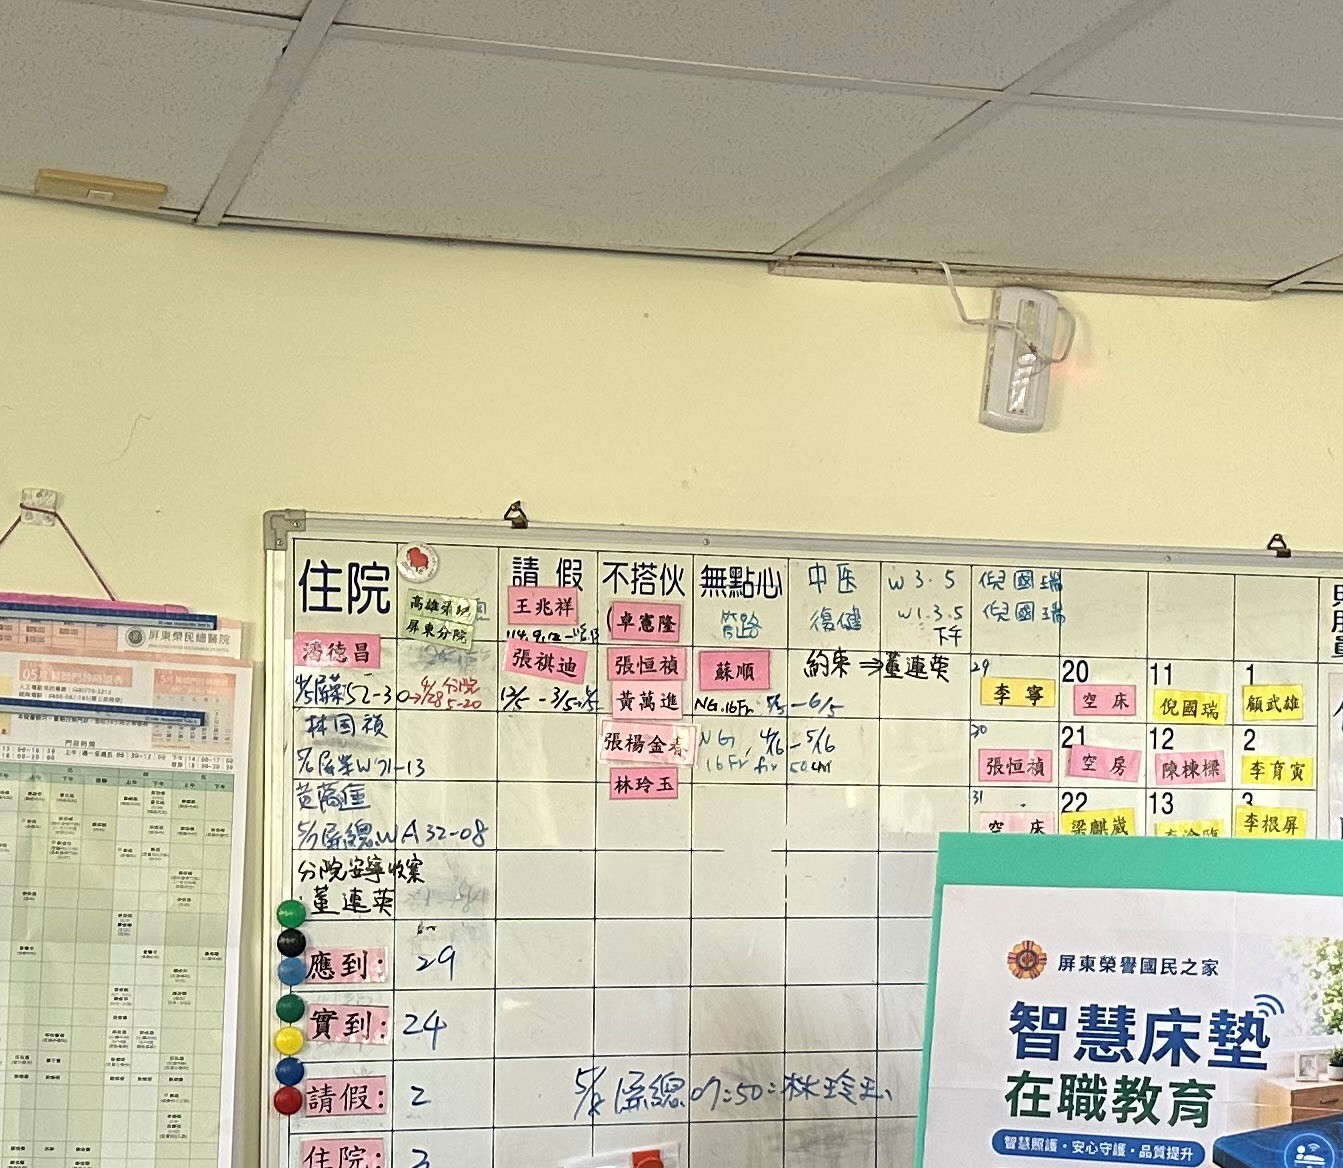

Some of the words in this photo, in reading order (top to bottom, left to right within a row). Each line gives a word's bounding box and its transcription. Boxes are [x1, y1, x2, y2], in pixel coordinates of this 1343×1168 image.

[299, 559, 390, 614] 住院
[603, 562, 685, 596] 不搭伙
[701, 564, 782, 599] 無點心
[513, 598, 575, 617] 王兆祥
[406, 619, 468, 644] 屏東分院
[617, 611, 676, 633] 卓憲隆
[933, 625, 963, 646] 下午
[513, 648, 577, 677] 張祺迪
[714, 661, 754, 682] 蘇順
[971, 659, 990, 677] 29
[1062, 660, 1088, 683] 20
[1150, 663, 1171, 685] 11
[1246, 664, 1254, 685] 1
[616, 690, 679, 711] 黃萬進
[994, 683, 1044, 706] 李寧
[1082, 692, 1130, 710] 空床
[1246, 695, 1300, 713] 顧武雄
[1160, 698, 1219, 720] 倪國瑞
[1062, 726, 1084, 748] 21
[1150, 727, 1174, 750] 12
[1244, 729, 1256, 750] 2
[1082, 753, 1127, 776] 空房
[1250, 760, 1306, 781] 李育寅
[614, 776, 674, 794] 林玲玉
[973, 790, 983, 805] 31
[1061, 792, 1087, 813] 22
[1149, 792, 1174, 814] 13
[1244, 812, 1299, 834] 李根屏
[416, 945, 456, 981] 29
[1057, 953, 1219, 978] 屏東榮譽國民之家
[403, 1010, 447, 1050] 24
[1008, 1001, 1271, 1071] 智慧床墊
[411, 1086, 431, 1105] 2
[1004, 1070, 1216, 1128] 在職教育
